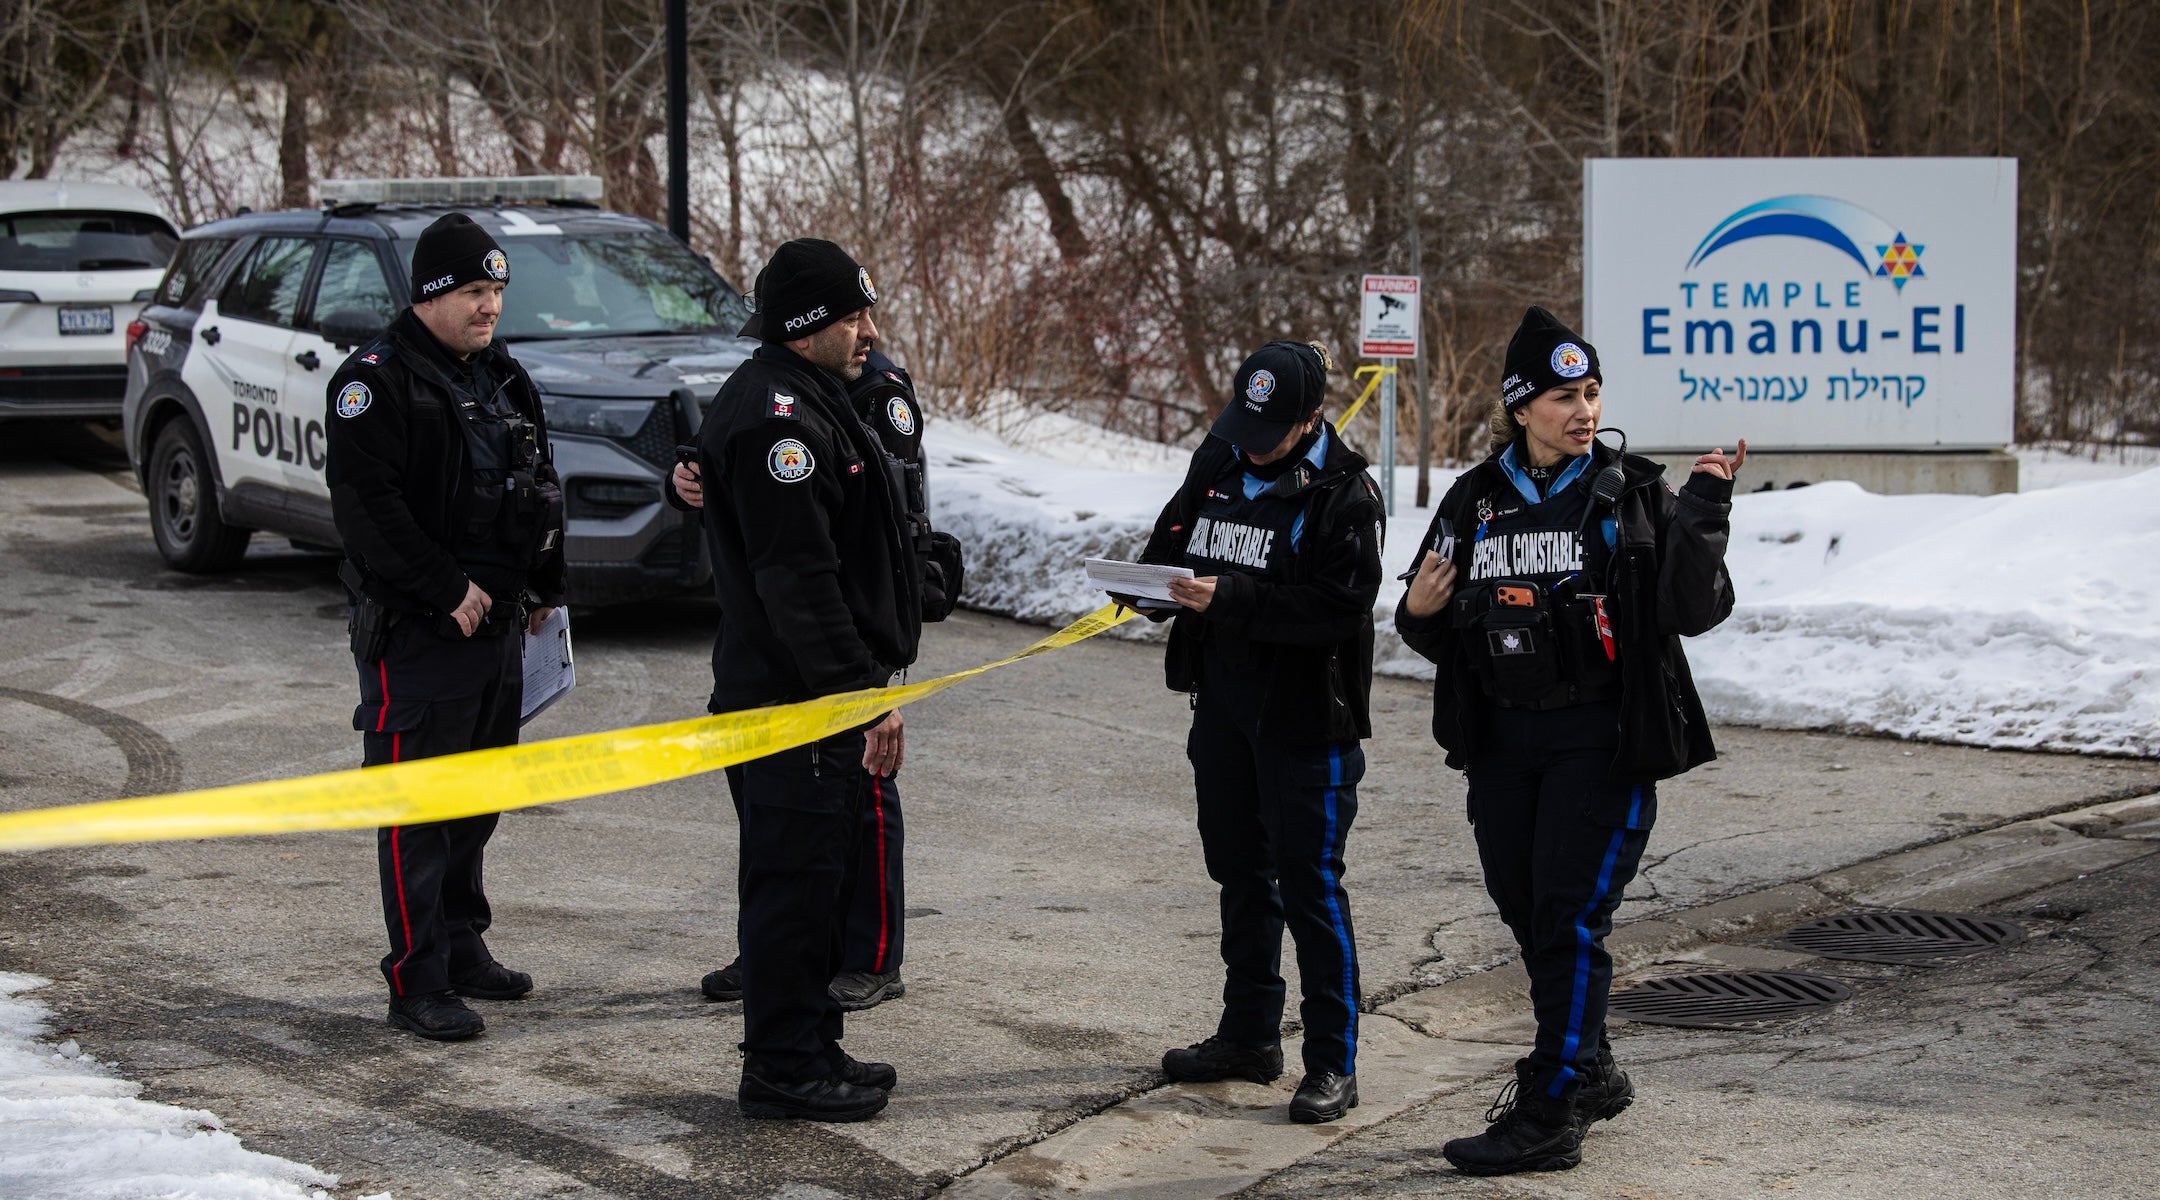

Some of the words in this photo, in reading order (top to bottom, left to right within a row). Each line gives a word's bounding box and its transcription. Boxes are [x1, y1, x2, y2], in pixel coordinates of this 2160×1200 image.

[422, 275, 455, 295] POLICE
[1680, 282, 1861, 308] TEMPLE
[784, 305, 829, 332] POLICE
[1643, 304, 1965, 355] Emanu-El
[232, 380, 278, 406] TORONTO
[1679, 368, 1808, 403] עמנו-אל
[1826, 367, 1926, 409] קהילת
[232, 401, 327, 472] POLIC
[773, 440, 805, 454] TORONTO
[780, 468, 805, 480] POLICE
[1209, 519, 1275, 569] CONSTABLE
[1469, 534, 1512, 581] SPECIAL
[1512, 531, 1584, 576] CONSTABLE
